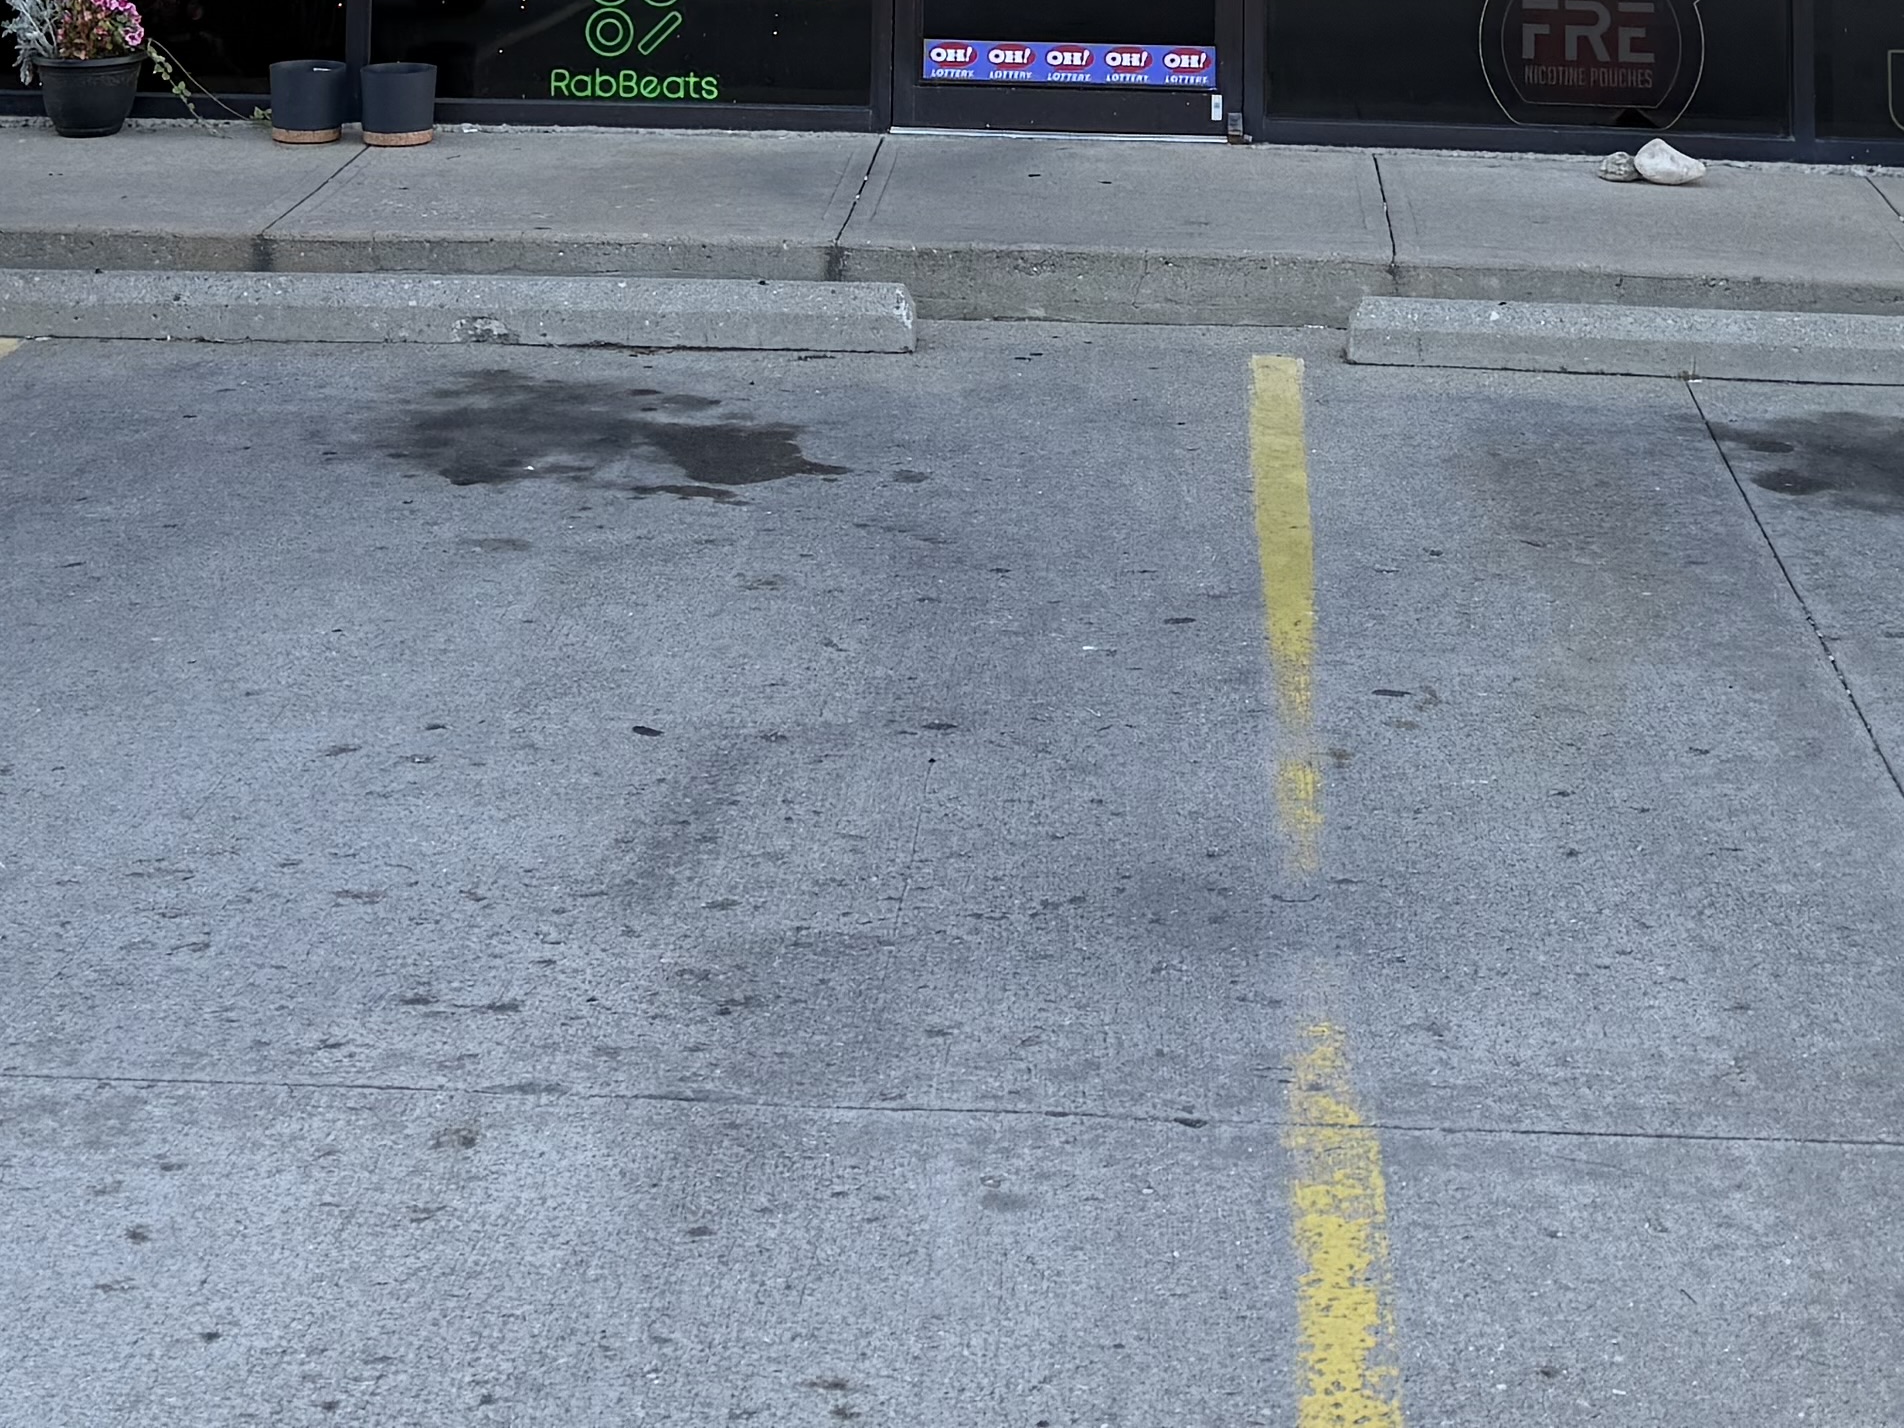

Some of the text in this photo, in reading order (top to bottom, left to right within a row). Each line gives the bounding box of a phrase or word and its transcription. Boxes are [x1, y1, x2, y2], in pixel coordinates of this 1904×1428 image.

[929, 46, 972, 64] OH!
[987, 47, 1031, 65] OH!
[1046, 49, 1089, 66] OH!
[1104, 50, 1148, 67] OH!
[1163, 52, 1207, 69] OH!
[550, 67, 719, 100] RabBeats
[1524, 65, 1654, 89] NICOTINE POUCHES
